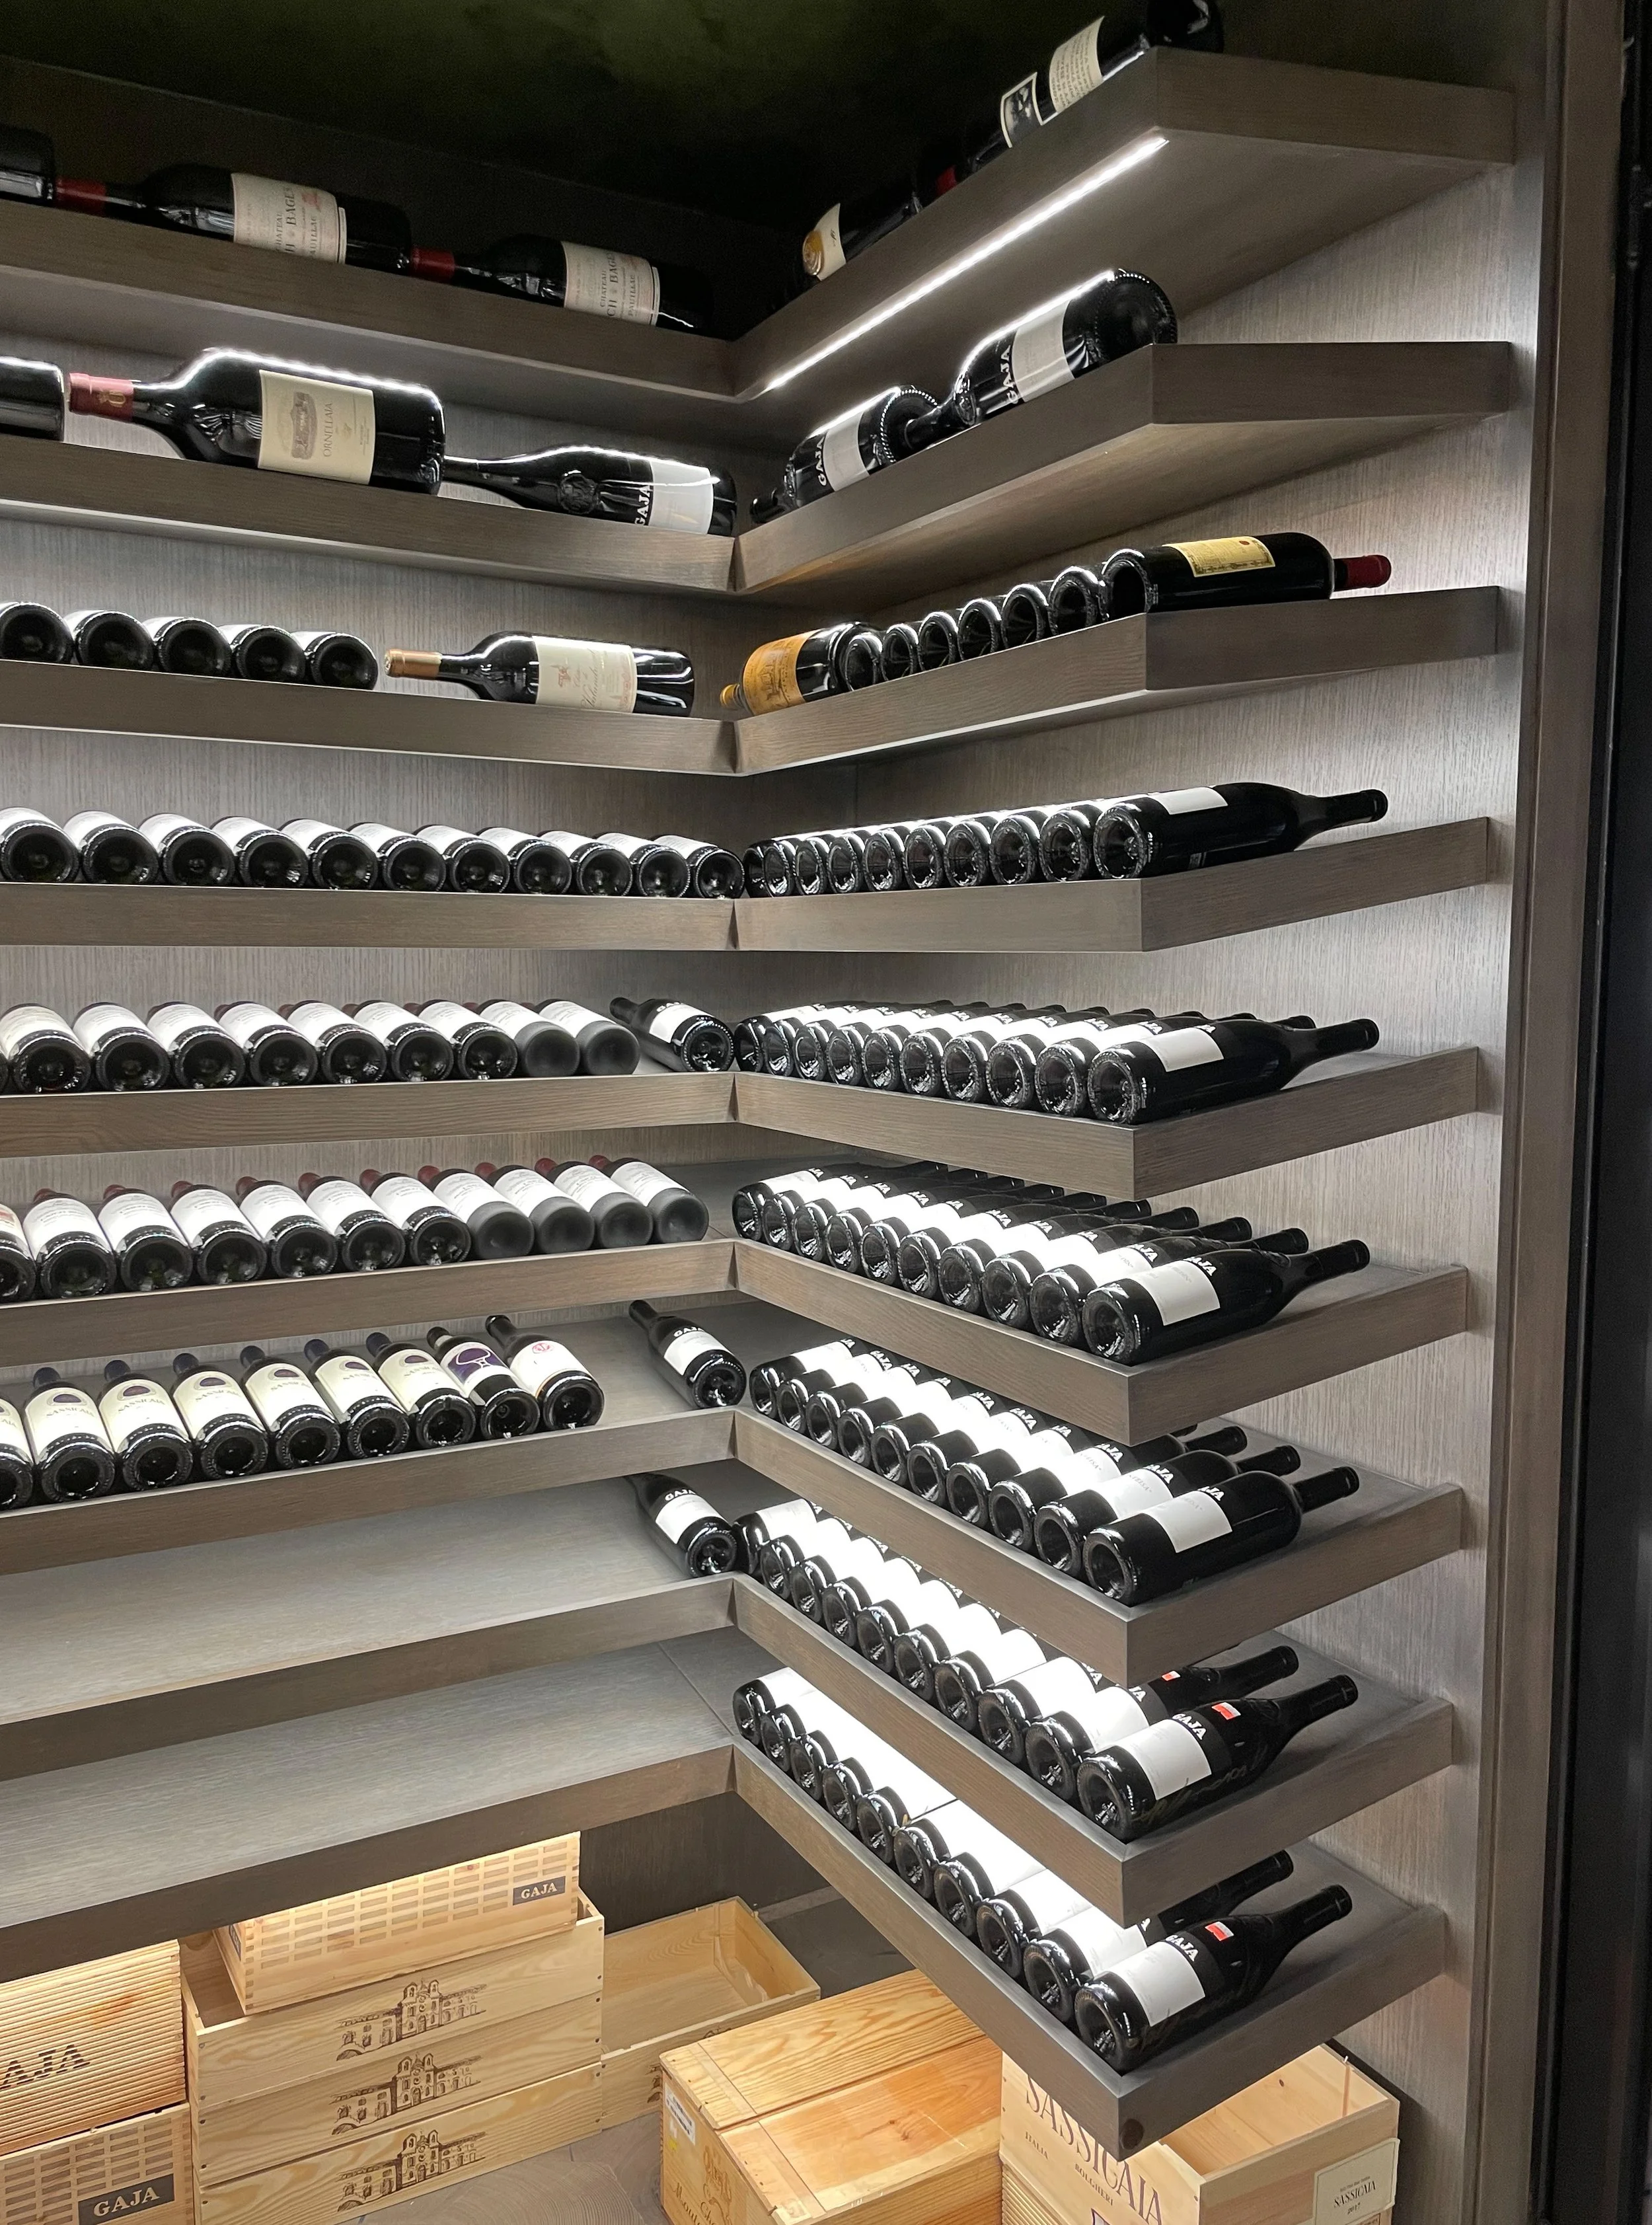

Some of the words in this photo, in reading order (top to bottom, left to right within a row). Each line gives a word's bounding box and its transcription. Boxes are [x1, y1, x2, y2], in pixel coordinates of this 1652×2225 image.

[1000, 345, 1019, 404] GAJA
[323, 402, 334, 457] ORNELLAIA
[634, 485, 652, 525] GAJA
[1183, 1257, 1217, 1276] AJA
[1129, 1686, 1146, 1702] JA
[1172, 1712, 1207, 1740] GAJA
[520, 1882, 557, 1899] GAJA
[1165, 1934, 1199, 1961] GAJA
[0, 2044, 91, 2089] AJA
[1026, 2131, 1049, 2162] ITALIA
[1074, 2163, 1114, 2207] BOLGHERI
[1333, 2180, 1376, 2208] SASSICAIA
[93, 2187, 160, 2216] GAJA
